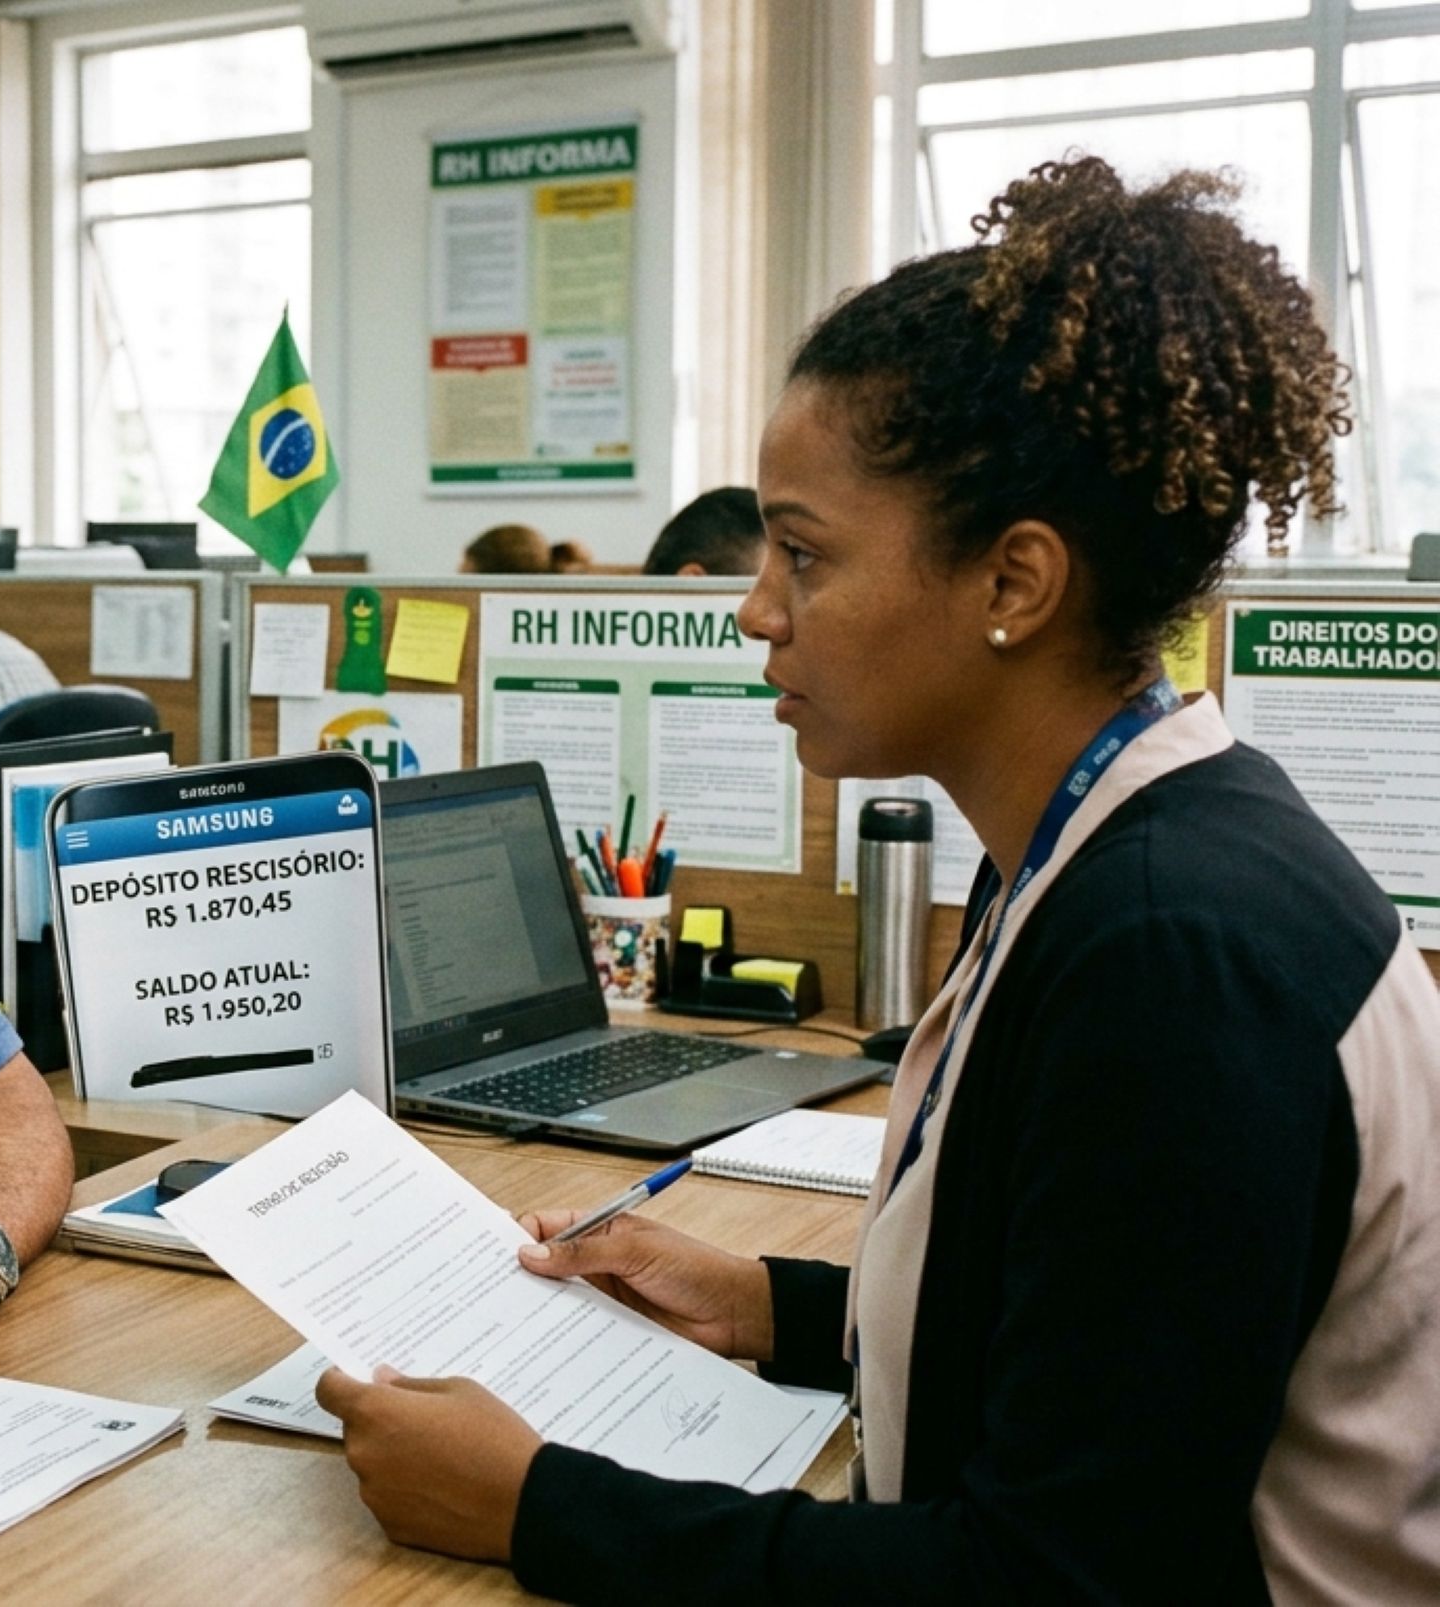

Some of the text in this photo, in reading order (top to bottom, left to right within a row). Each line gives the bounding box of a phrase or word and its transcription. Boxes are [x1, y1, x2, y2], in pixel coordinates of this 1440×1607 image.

[439, 136, 632, 181] RH INFORMA
[512, 609, 742, 648] RH INFORMA
[1269, 621, 1438, 645] DIREITOS DO
[1252, 645, 1440, 671] TRABALHADO
[156, 807, 275, 840] SAMSUNG
[71, 849, 365, 906] DEPÓSITO RESCISÓRIO:
[146, 890, 292, 929] R$ 1.870,45
[135, 960, 311, 1000] SALDO ATUAL:
[165, 990, 302, 1027] R$ 1.950,20
